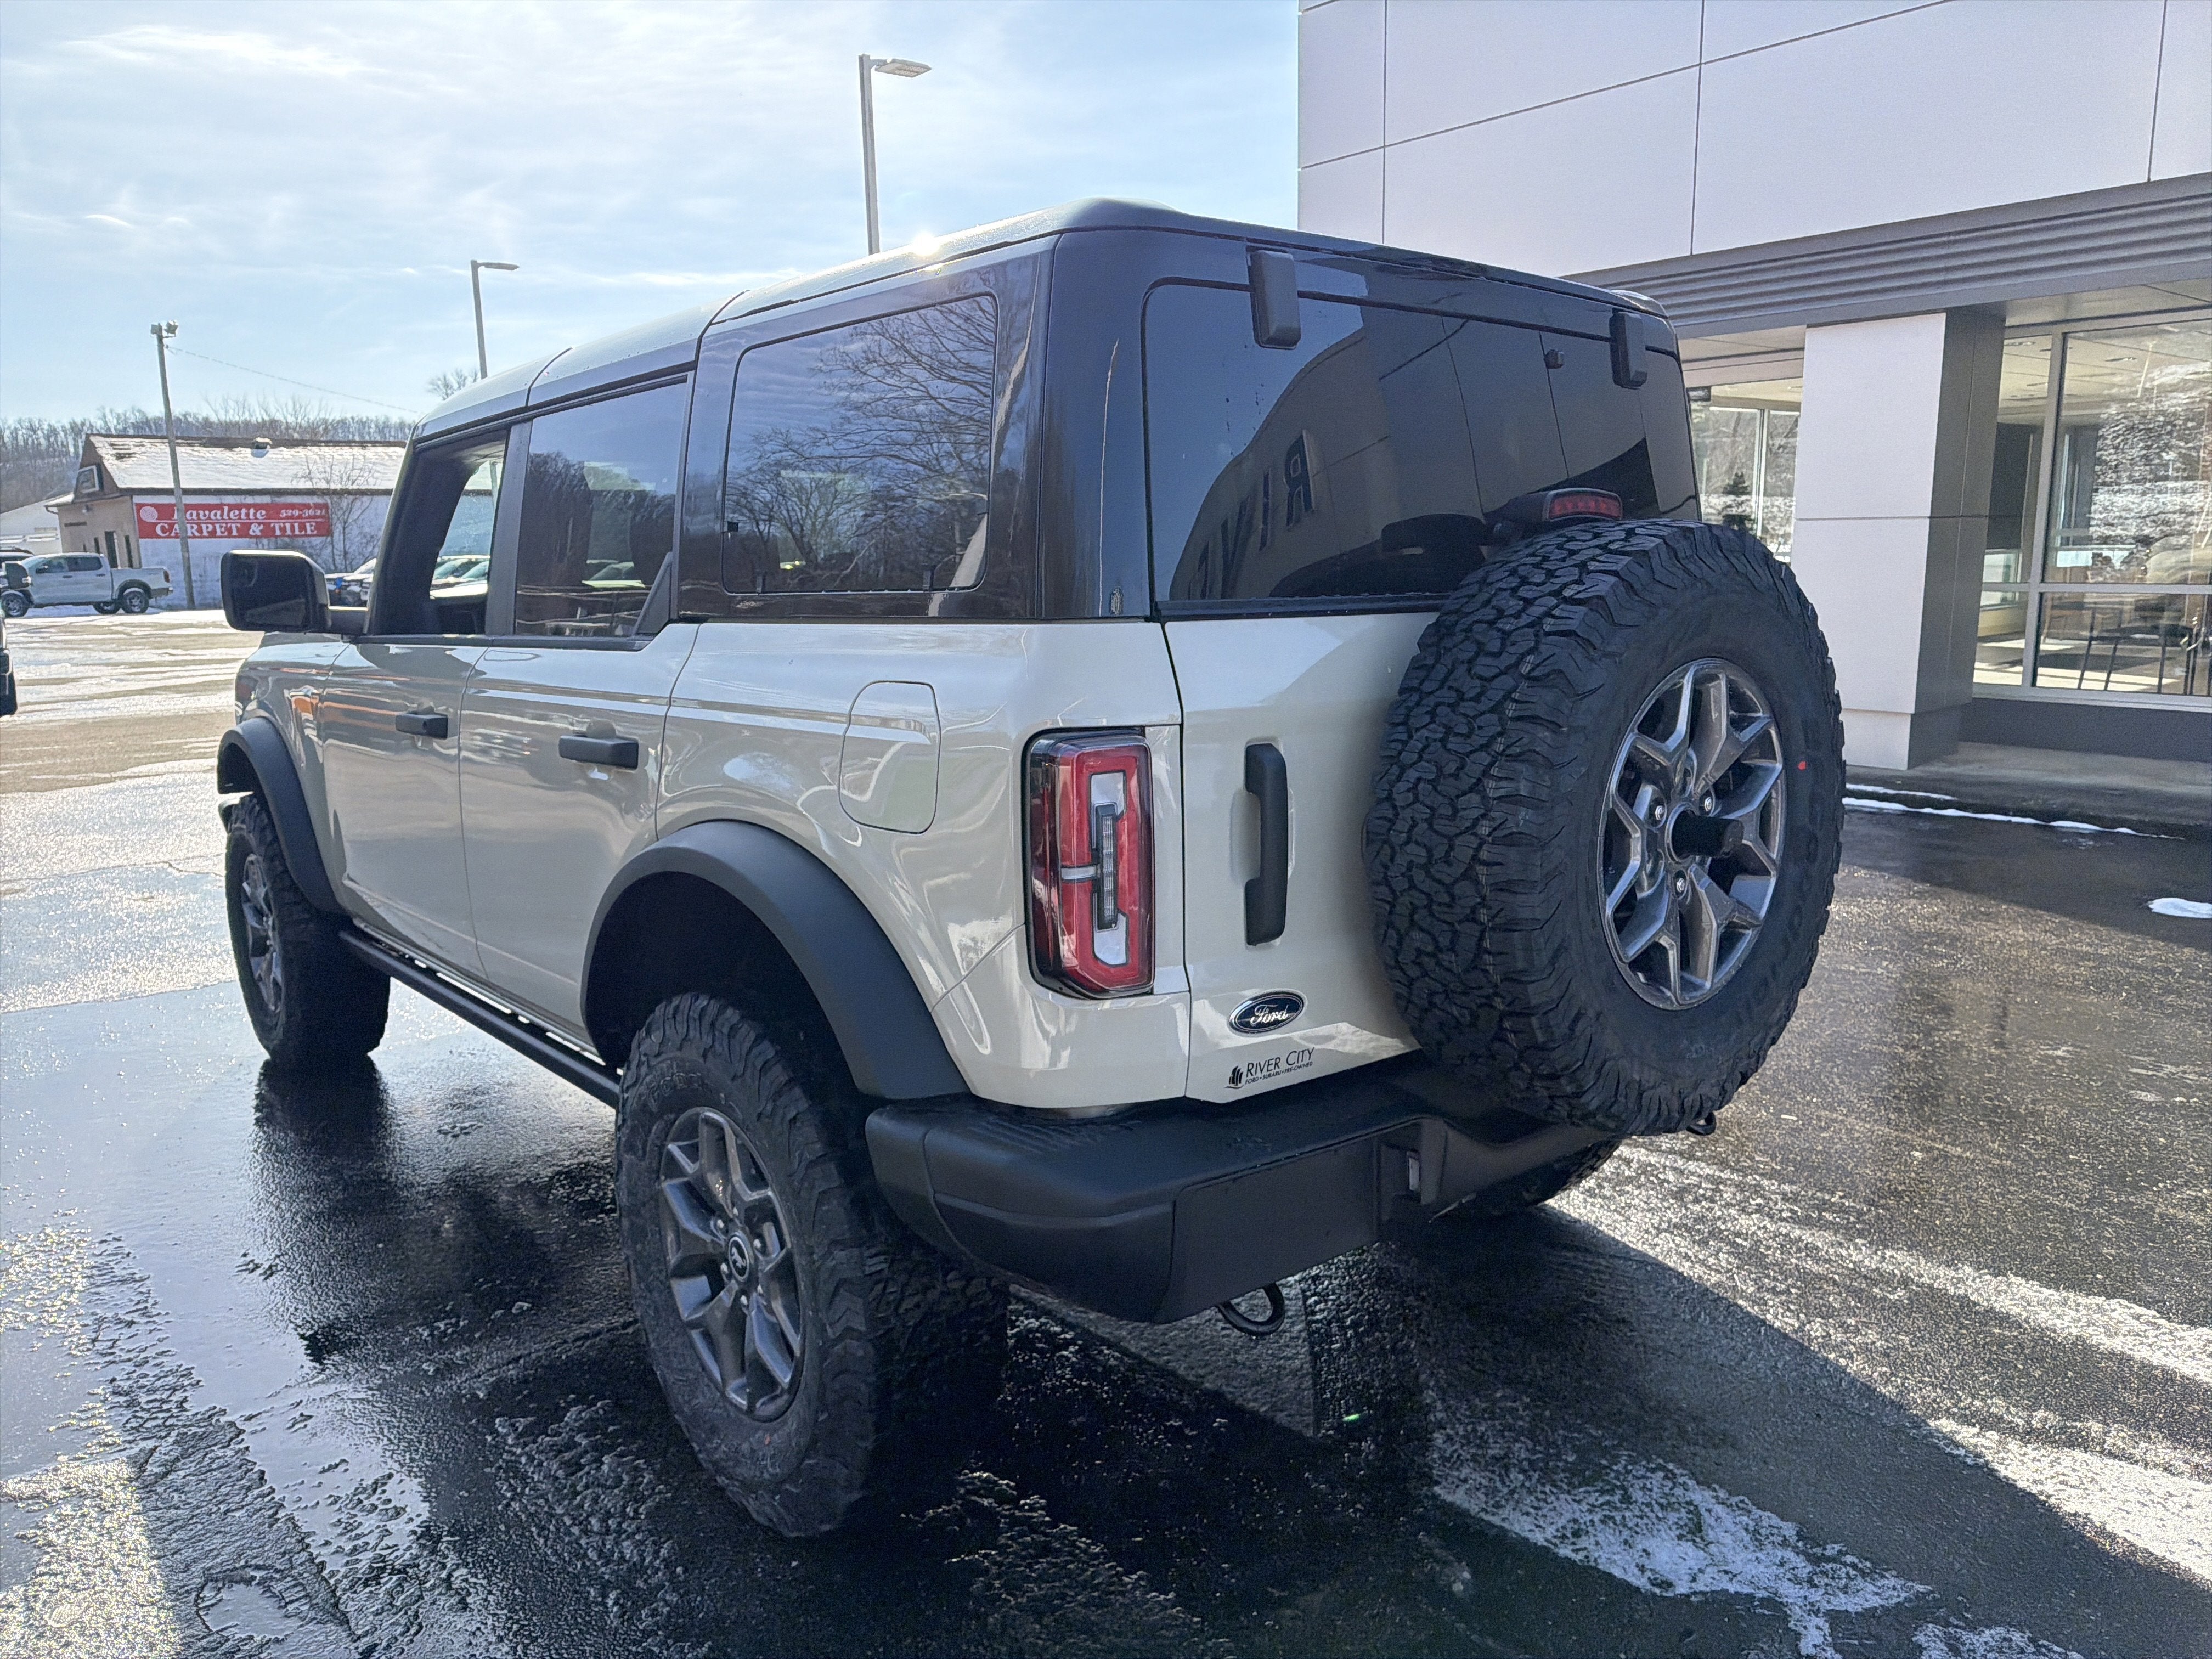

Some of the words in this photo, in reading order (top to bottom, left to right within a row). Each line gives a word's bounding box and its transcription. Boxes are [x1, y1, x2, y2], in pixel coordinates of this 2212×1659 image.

[156, 522, 241, 537] CARPET
[249, 522, 264, 536] &
[270, 522, 317, 536] TILE
[1250, 1003, 1289, 1025] Ford
[1246, 1056, 1282, 1079] RIVER
[1286, 1046, 1315, 1066] CITY
[1245, 1076, 1259, 1085] FORD
[1262, 1069, 1282, 1081] SUBARU
